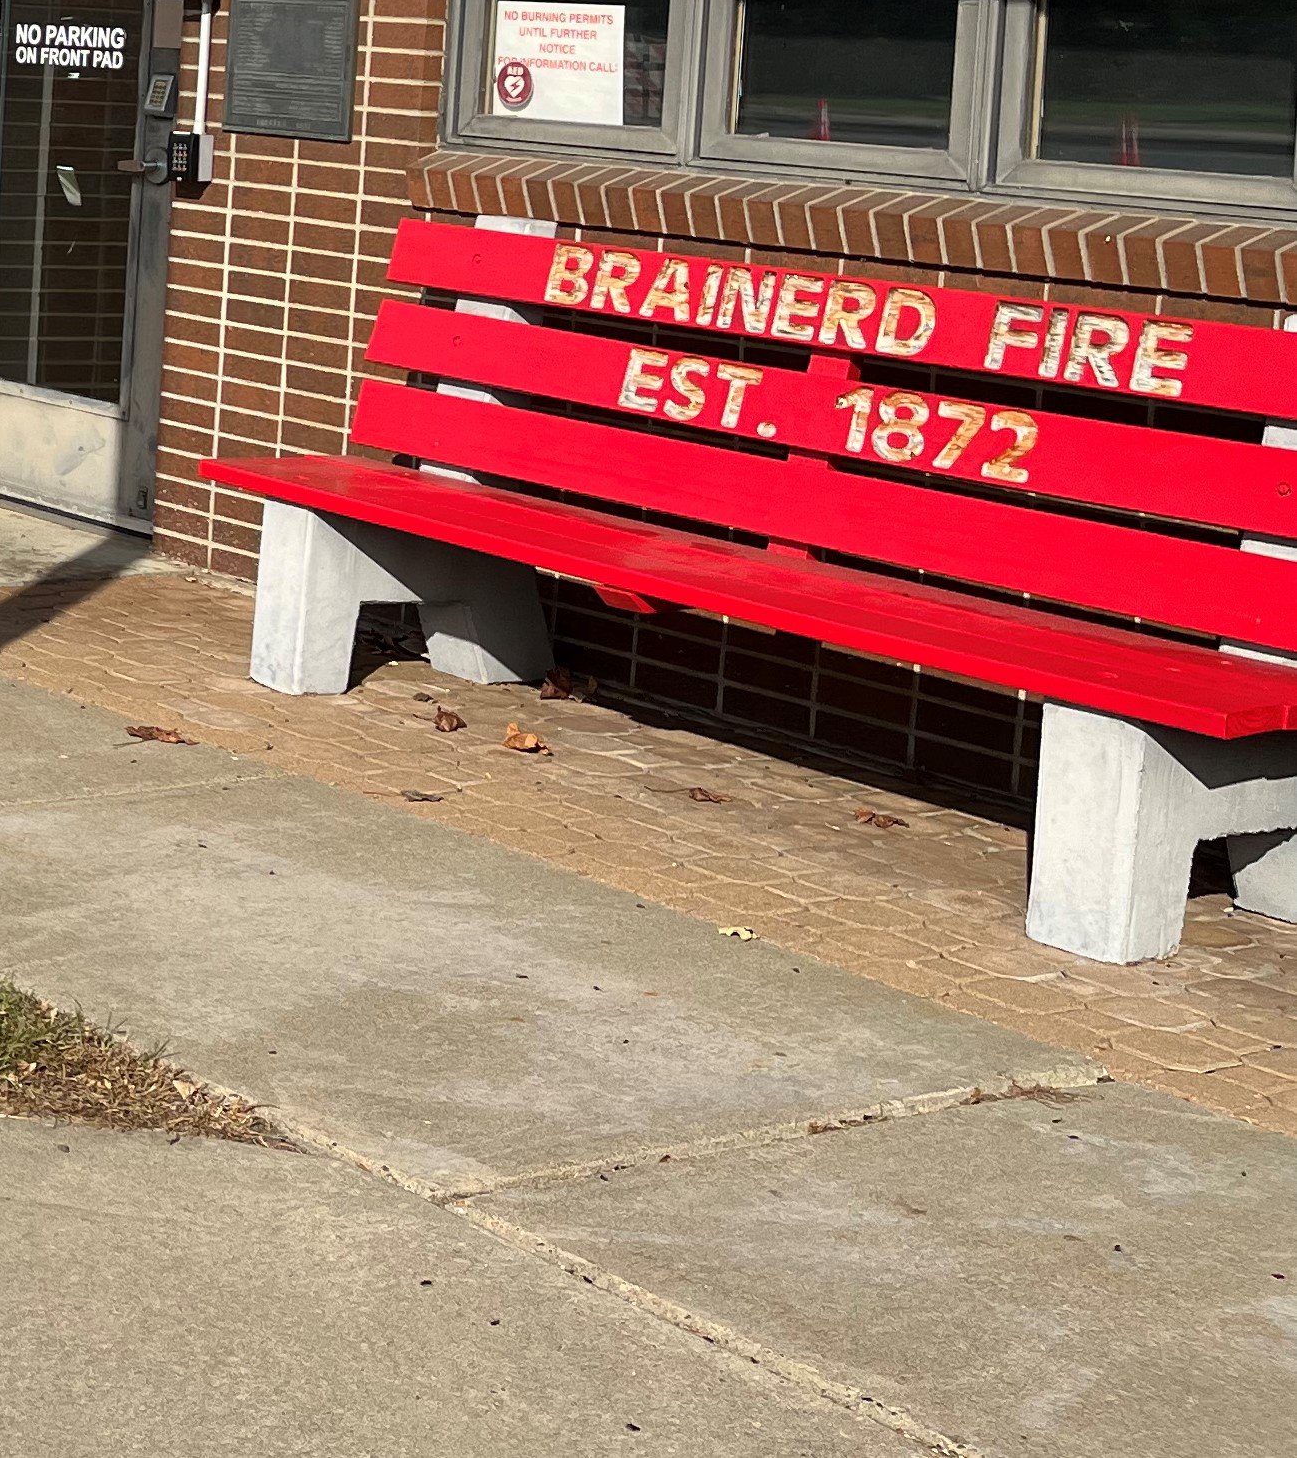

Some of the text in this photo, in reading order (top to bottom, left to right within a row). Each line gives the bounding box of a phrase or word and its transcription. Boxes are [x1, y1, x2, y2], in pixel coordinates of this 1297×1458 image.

[504, 10, 614, 25] NO BURNING PERMITS
[15, 23, 126, 49] NO PARKING
[519, 26, 597, 40] UNTIL FURTHER
[15, 46, 124, 69] ON FRONT PAD
[539, 43, 576, 55] NOTICE
[589, 61, 618, 73] CALL:
[542, 243, 1196, 398] BRAINERD FIRE
[616, 347, 1040, 484] EST. 1872
